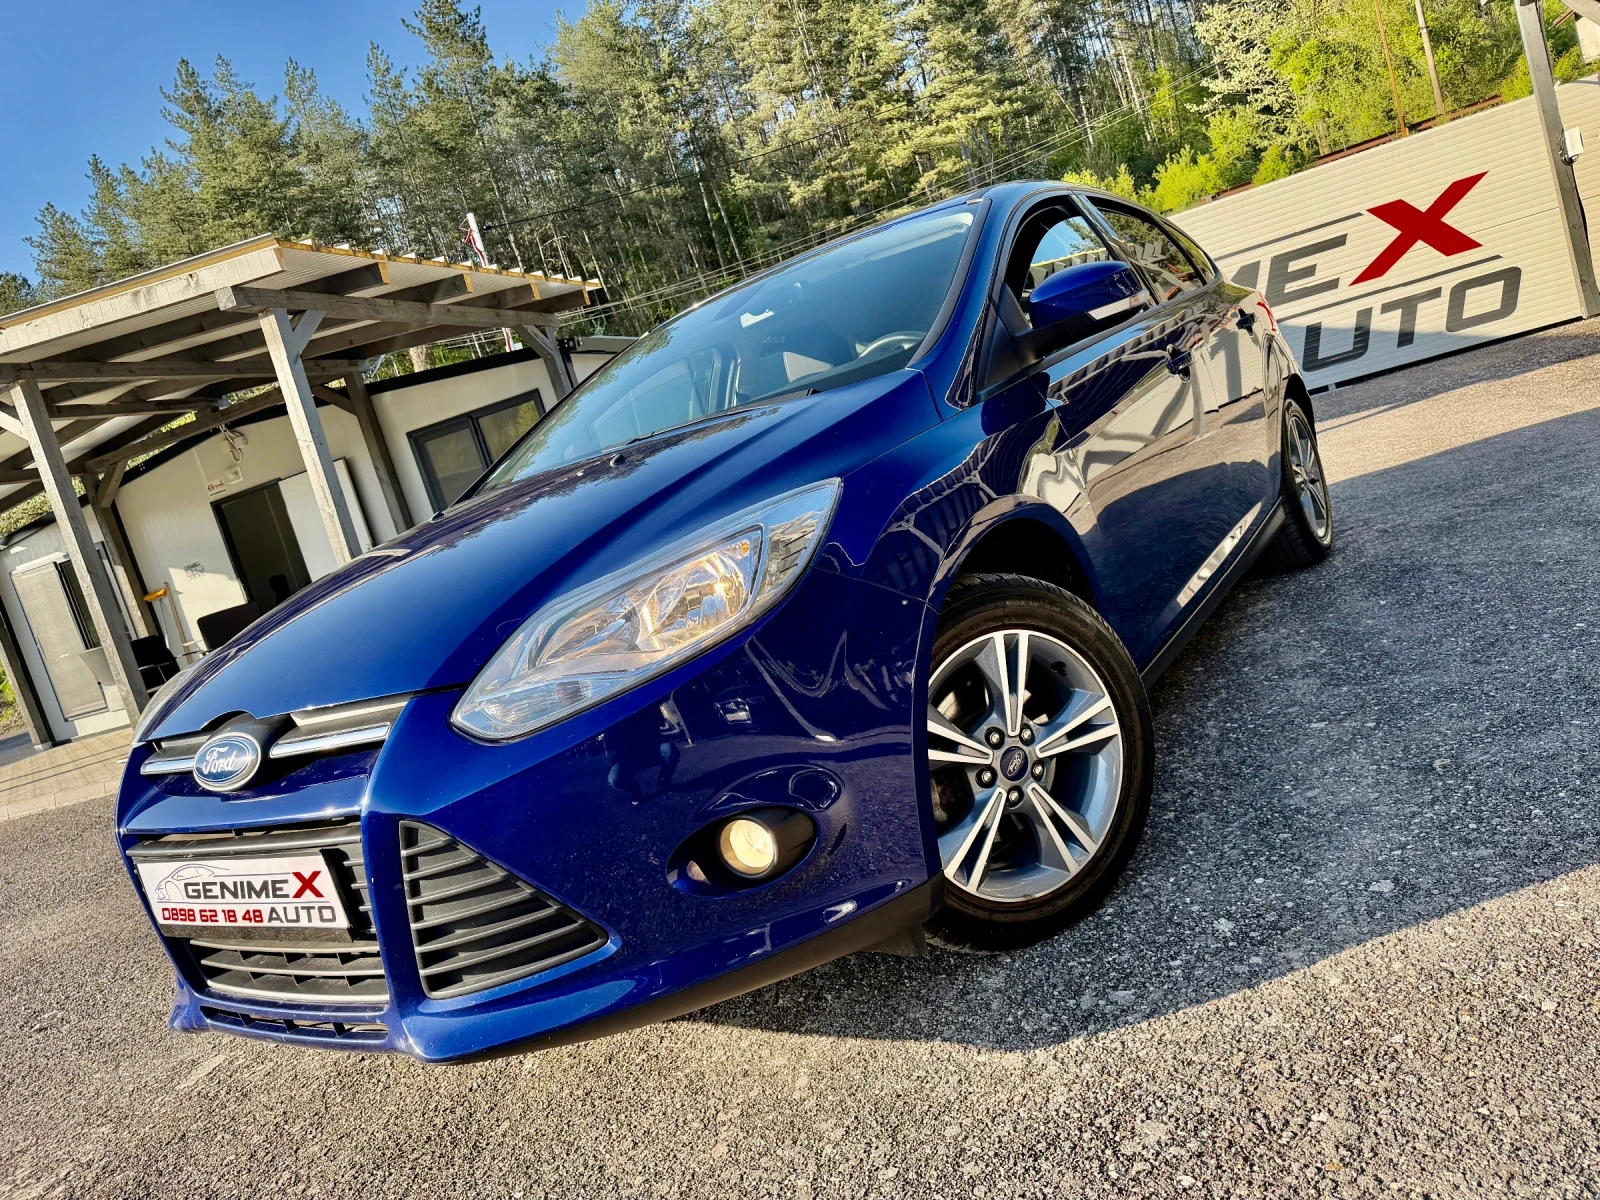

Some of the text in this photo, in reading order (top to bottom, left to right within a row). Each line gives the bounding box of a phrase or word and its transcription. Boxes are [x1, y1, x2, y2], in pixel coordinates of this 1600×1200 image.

[1301, 266, 1522, 372] UTO
[202, 746, 237, 775] Ford
[184, 870, 325, 900] GENIMEX
[161, 907, 264, 924] 0898 62 18 48
[268, 905, 336, 924] AUTO
